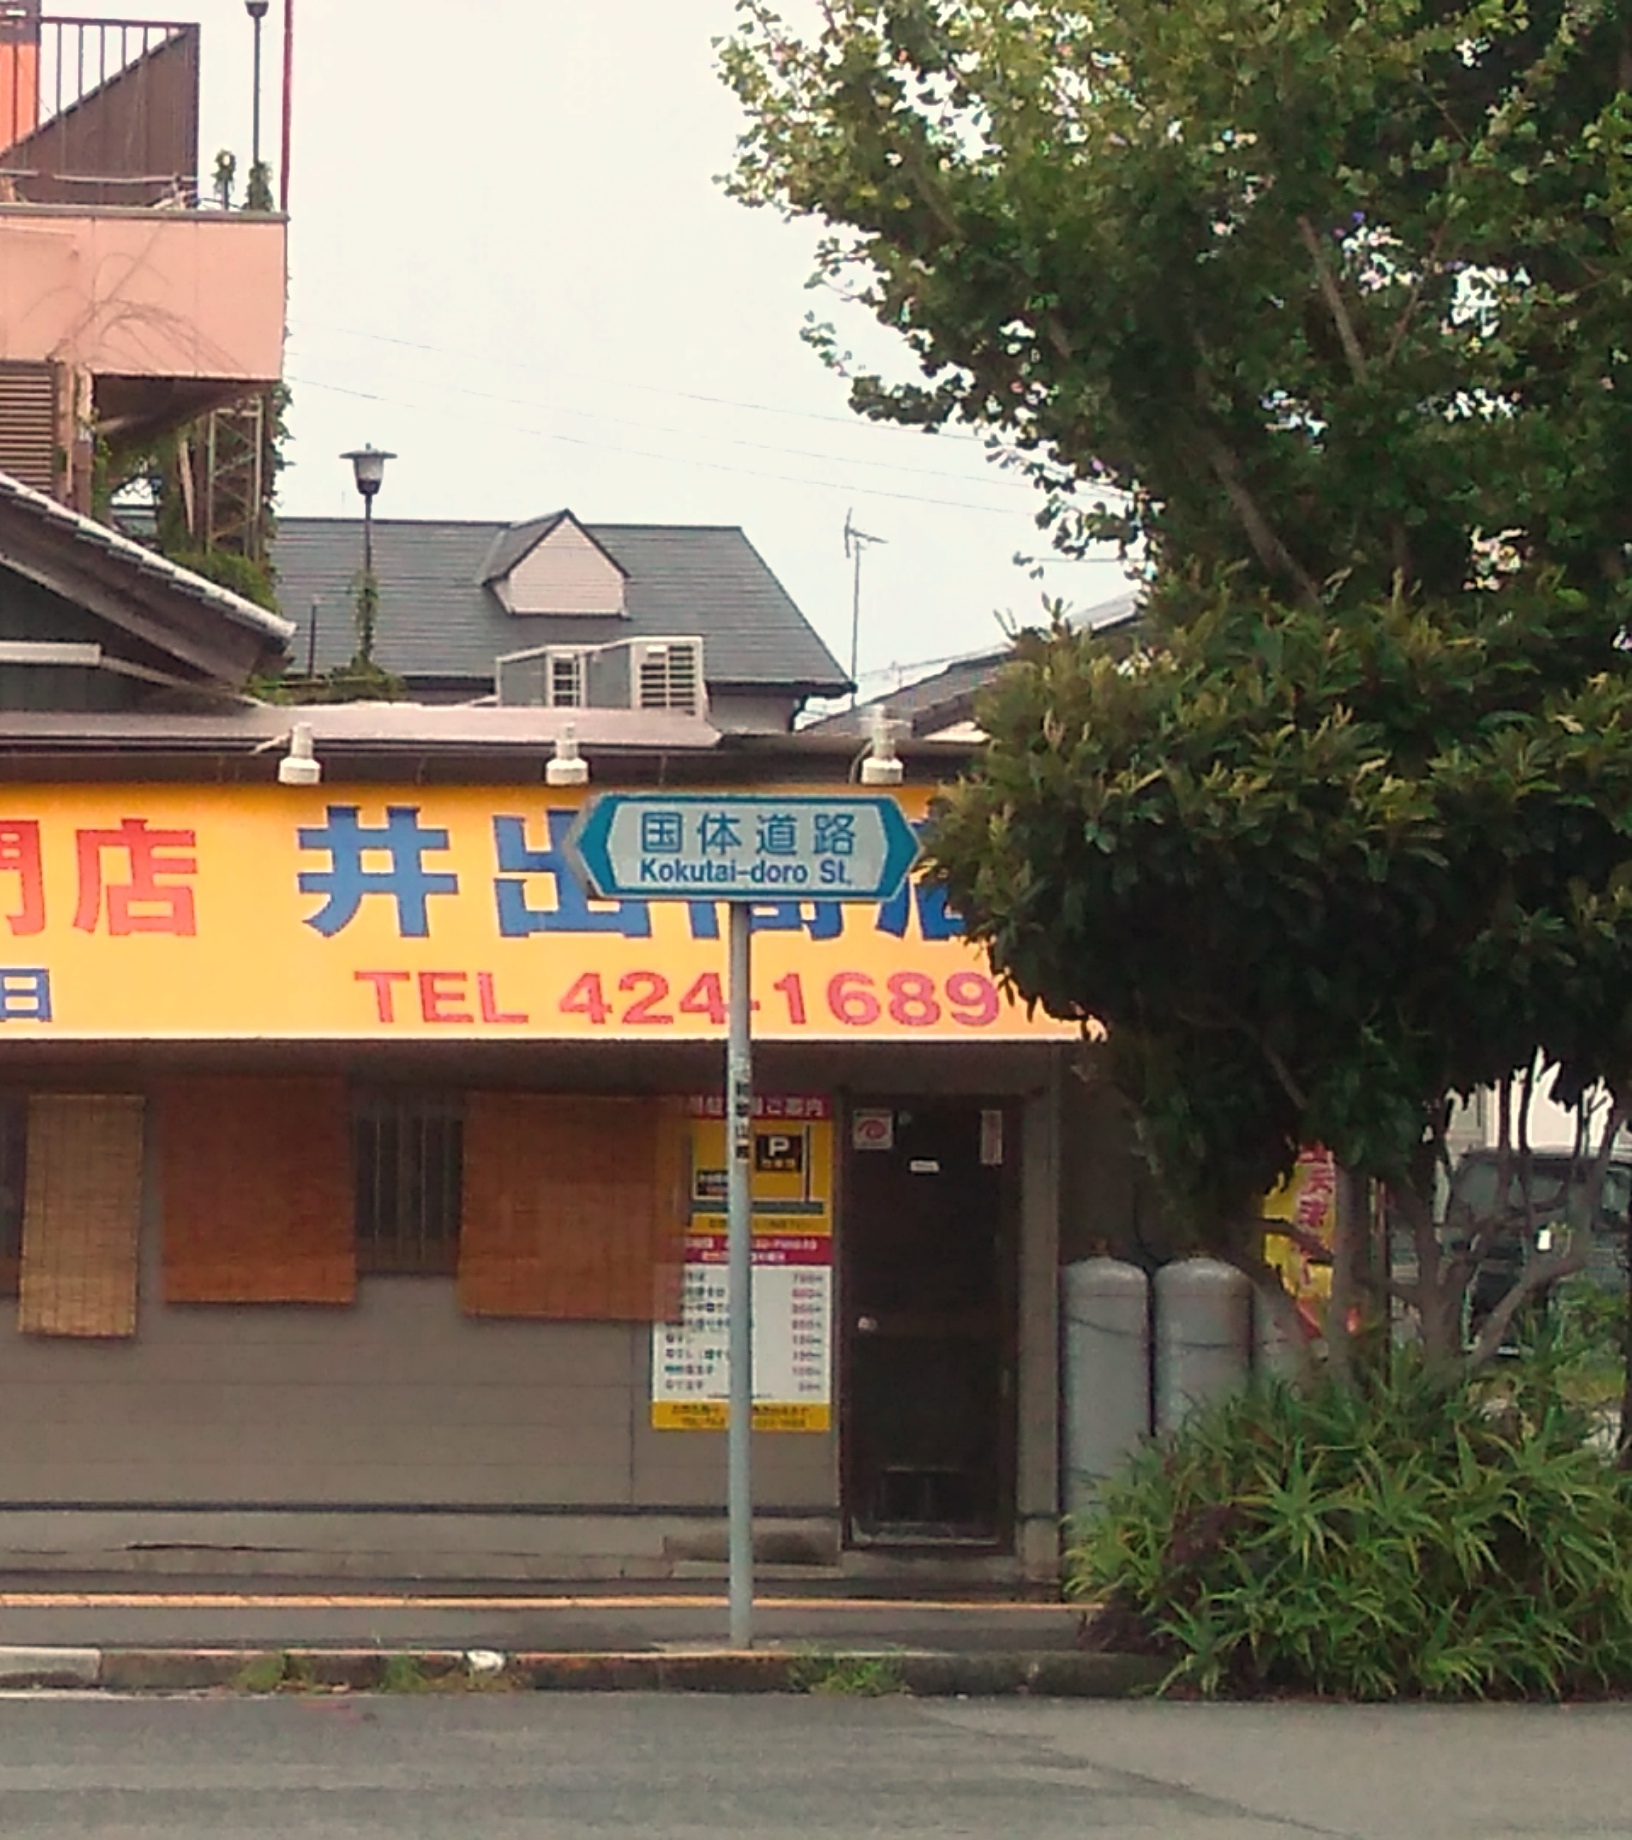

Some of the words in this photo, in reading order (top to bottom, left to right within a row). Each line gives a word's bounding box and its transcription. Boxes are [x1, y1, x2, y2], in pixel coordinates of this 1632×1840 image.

[641, 811, 855, 855] 国体道路
[298, 805, 968, 938] 井出
[640, 858, 808, 883] Kokutai-doro
[819, 859, 853, 885] St.
[354, 970, 529, 1024] TEL
[768, 1136, 790, 1157] P
